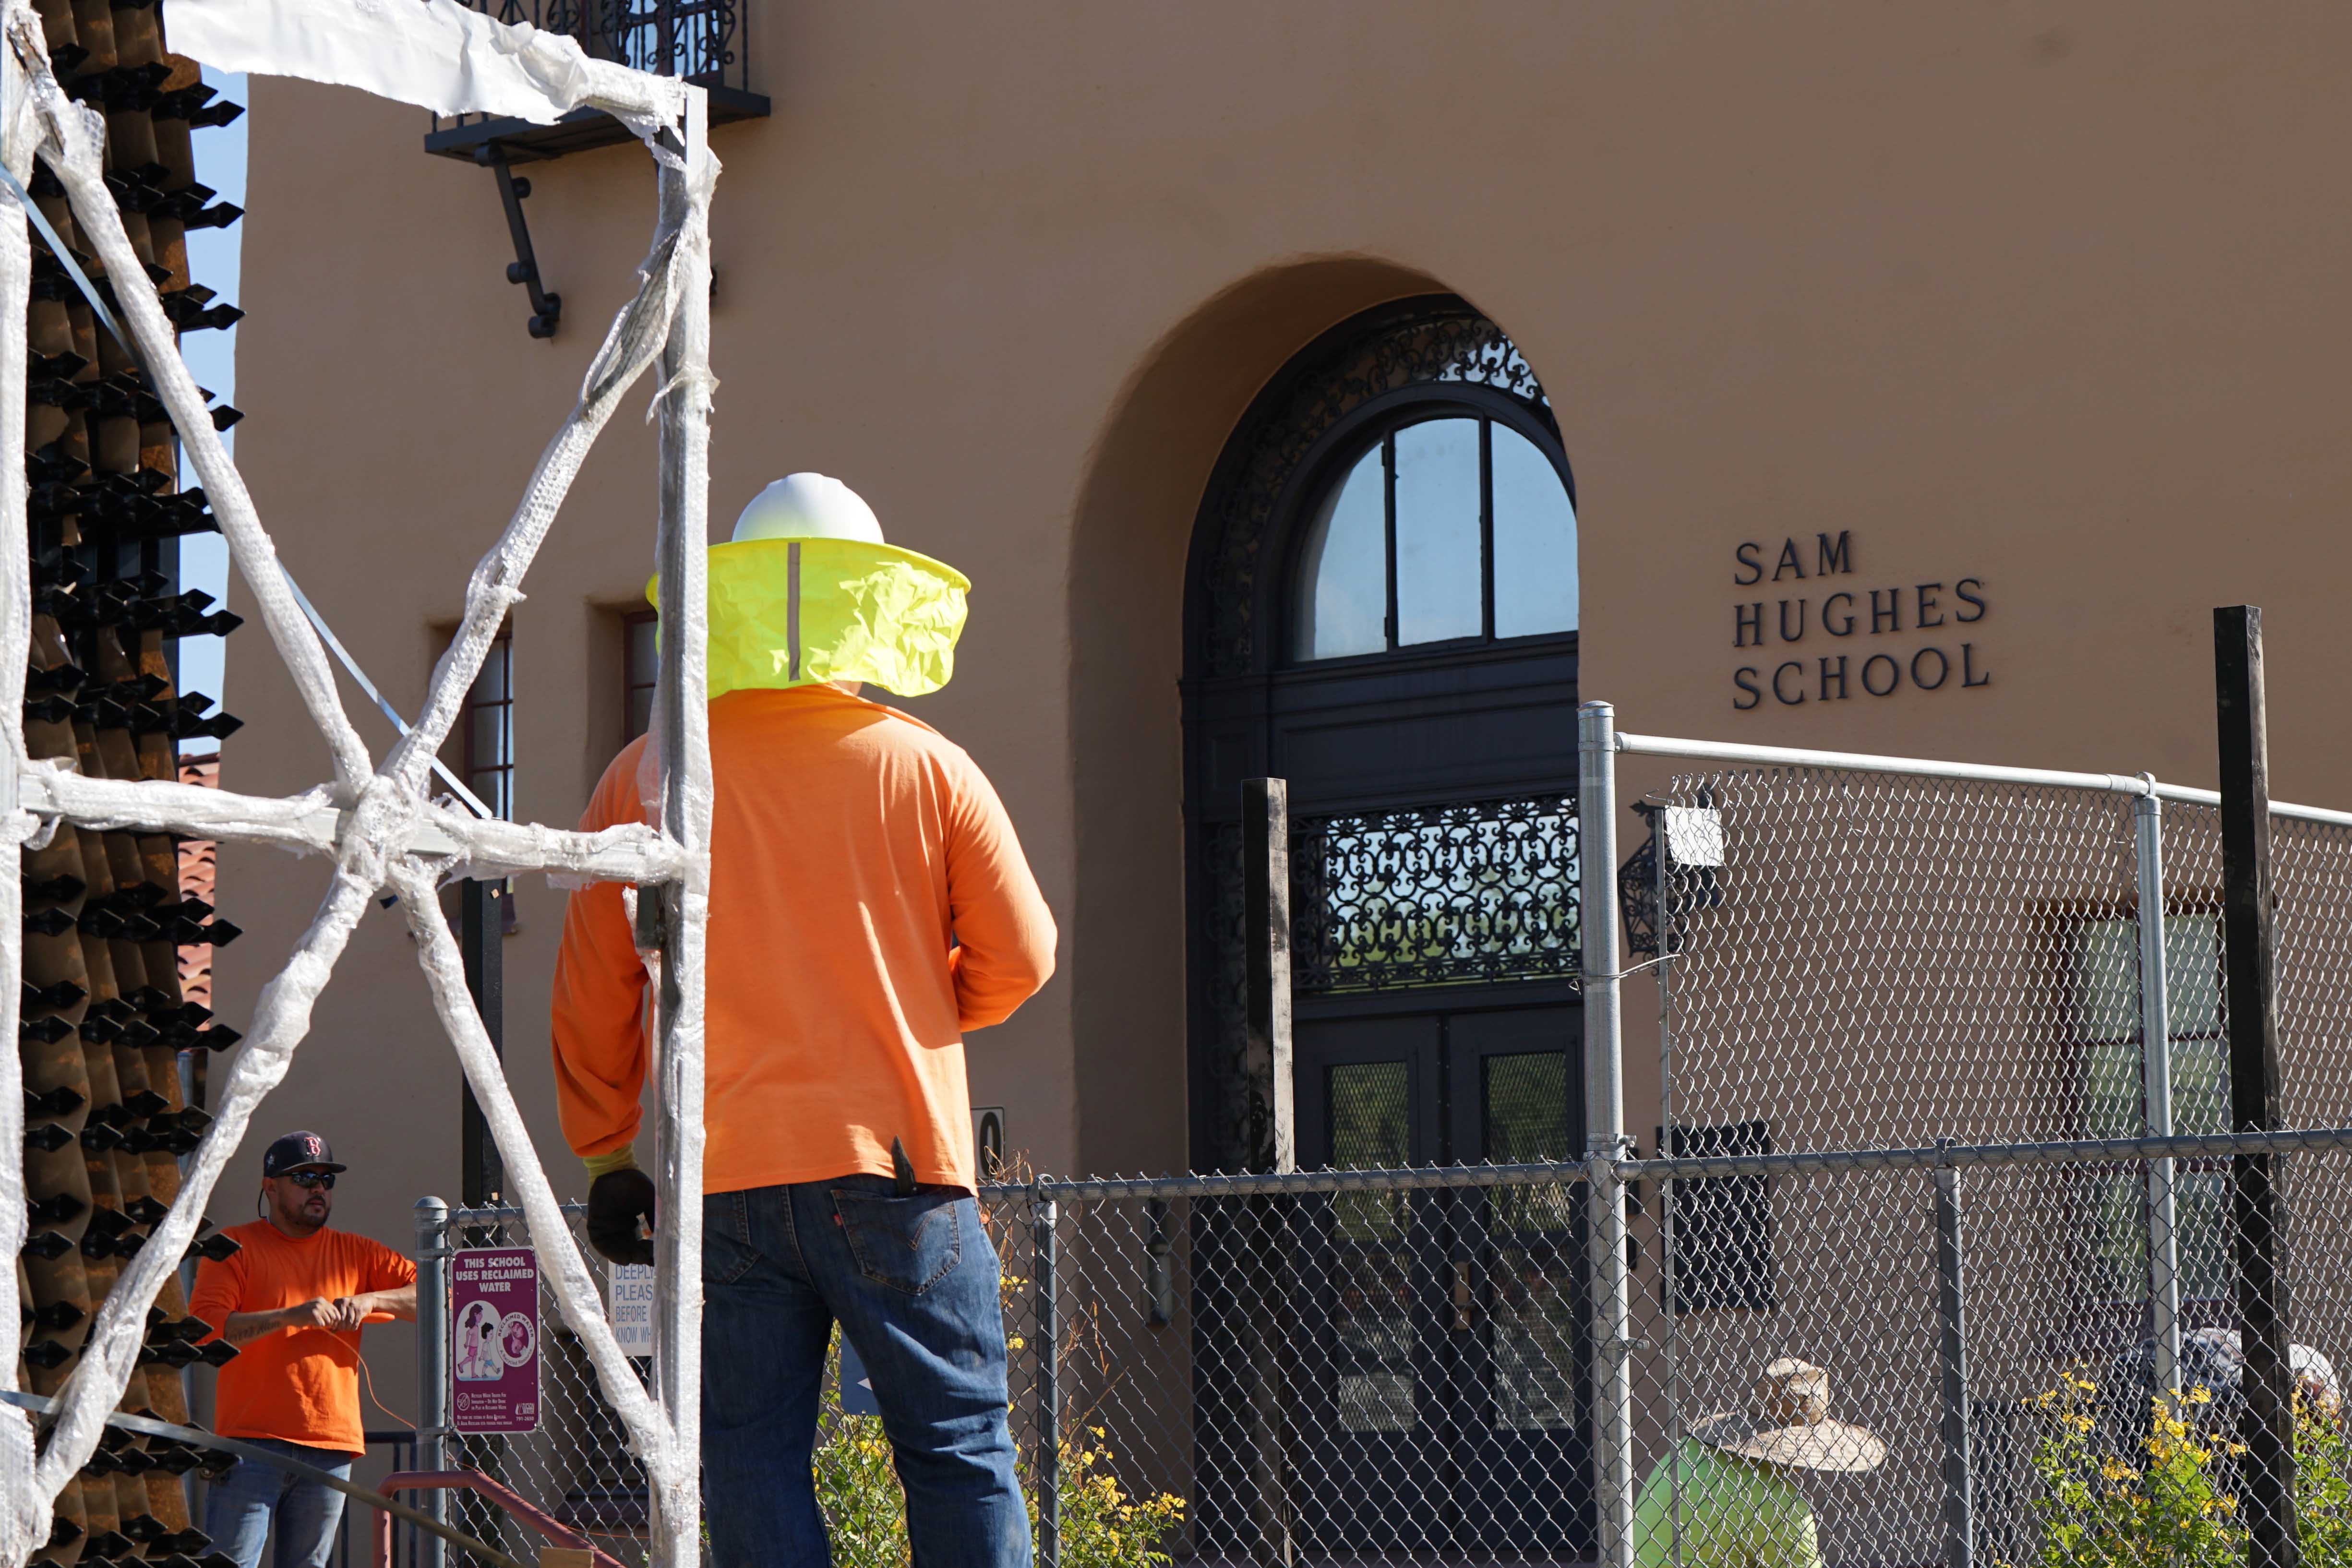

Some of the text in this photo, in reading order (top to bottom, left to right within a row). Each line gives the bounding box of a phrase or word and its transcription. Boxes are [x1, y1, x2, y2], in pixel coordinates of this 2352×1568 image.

[1734, 530, 1852, 585] SAM
[1733, 578, 1986, 647] HUGHES
[1733, 643, 1989, 710] SCHOOL
[304, 1137, 321, 1156] B
[464, 1257, 526, 1268] THIS SCHOOL
[456, 1269, 534, 1281] USES RECLAIMED
[479, 1282, 511, 1292] WATER
[615, 1284, 653, 1301] PLEAS
[615, 1306, 647, 1322] BEFORE
[498, 1314, 534, 1337] RECLAIMED WATER
[616, 1326, 652, 1343] KNOW WH
